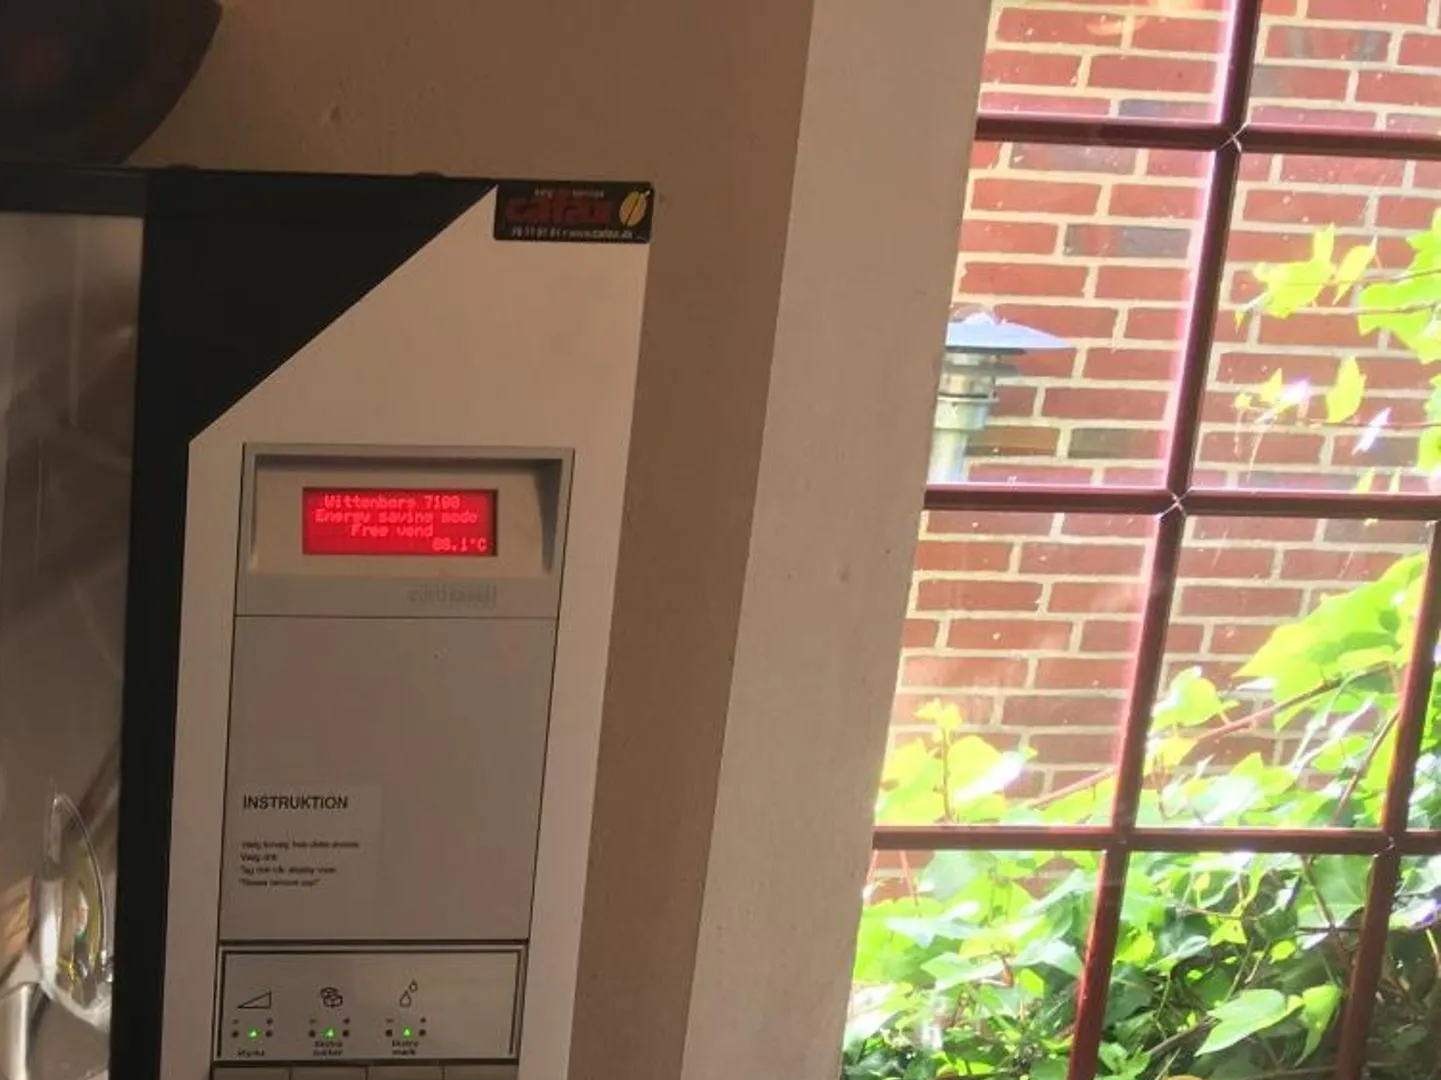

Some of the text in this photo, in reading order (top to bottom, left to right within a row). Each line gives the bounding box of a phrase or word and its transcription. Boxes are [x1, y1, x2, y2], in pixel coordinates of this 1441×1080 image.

[315, 508, 478, 524] Energy saving mode
[350, 523, 434, 537] Free vend
[243, 794, 349, 810] INSTRUKTION
